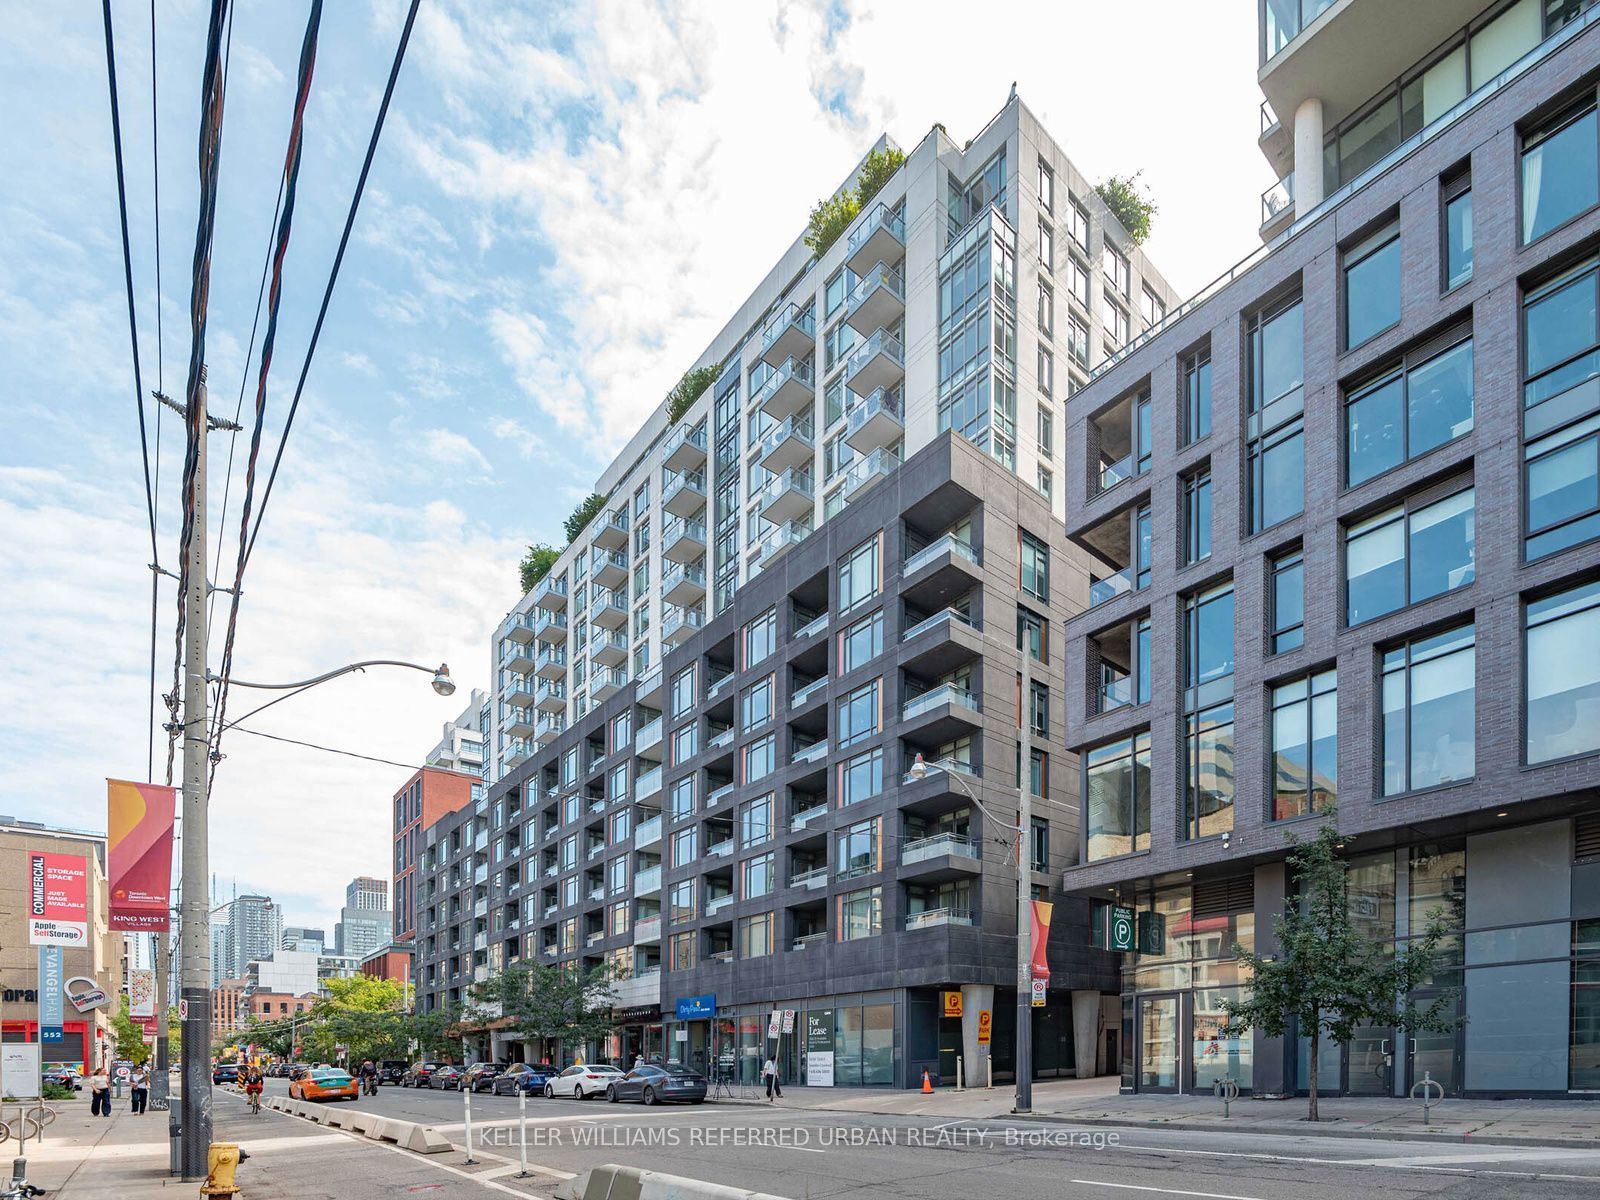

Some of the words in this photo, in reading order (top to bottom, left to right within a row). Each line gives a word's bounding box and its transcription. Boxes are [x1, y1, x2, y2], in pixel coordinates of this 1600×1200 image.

[47, 868, 85, 876] STORAGE
[33, 857, 44, 915] COMMERCIAL
[1115, 907, 1131, 915] PUBLIC
[1113, 912, 1132, 920] PARKING
[34, 921, 56, 930] Apple
[1119, 924, 1128, 940] P
[46, 948, 58, 998] EVANGEL
[809, 1016, 820, 1026] For
[809, 1027, 827, 1036] Lease
